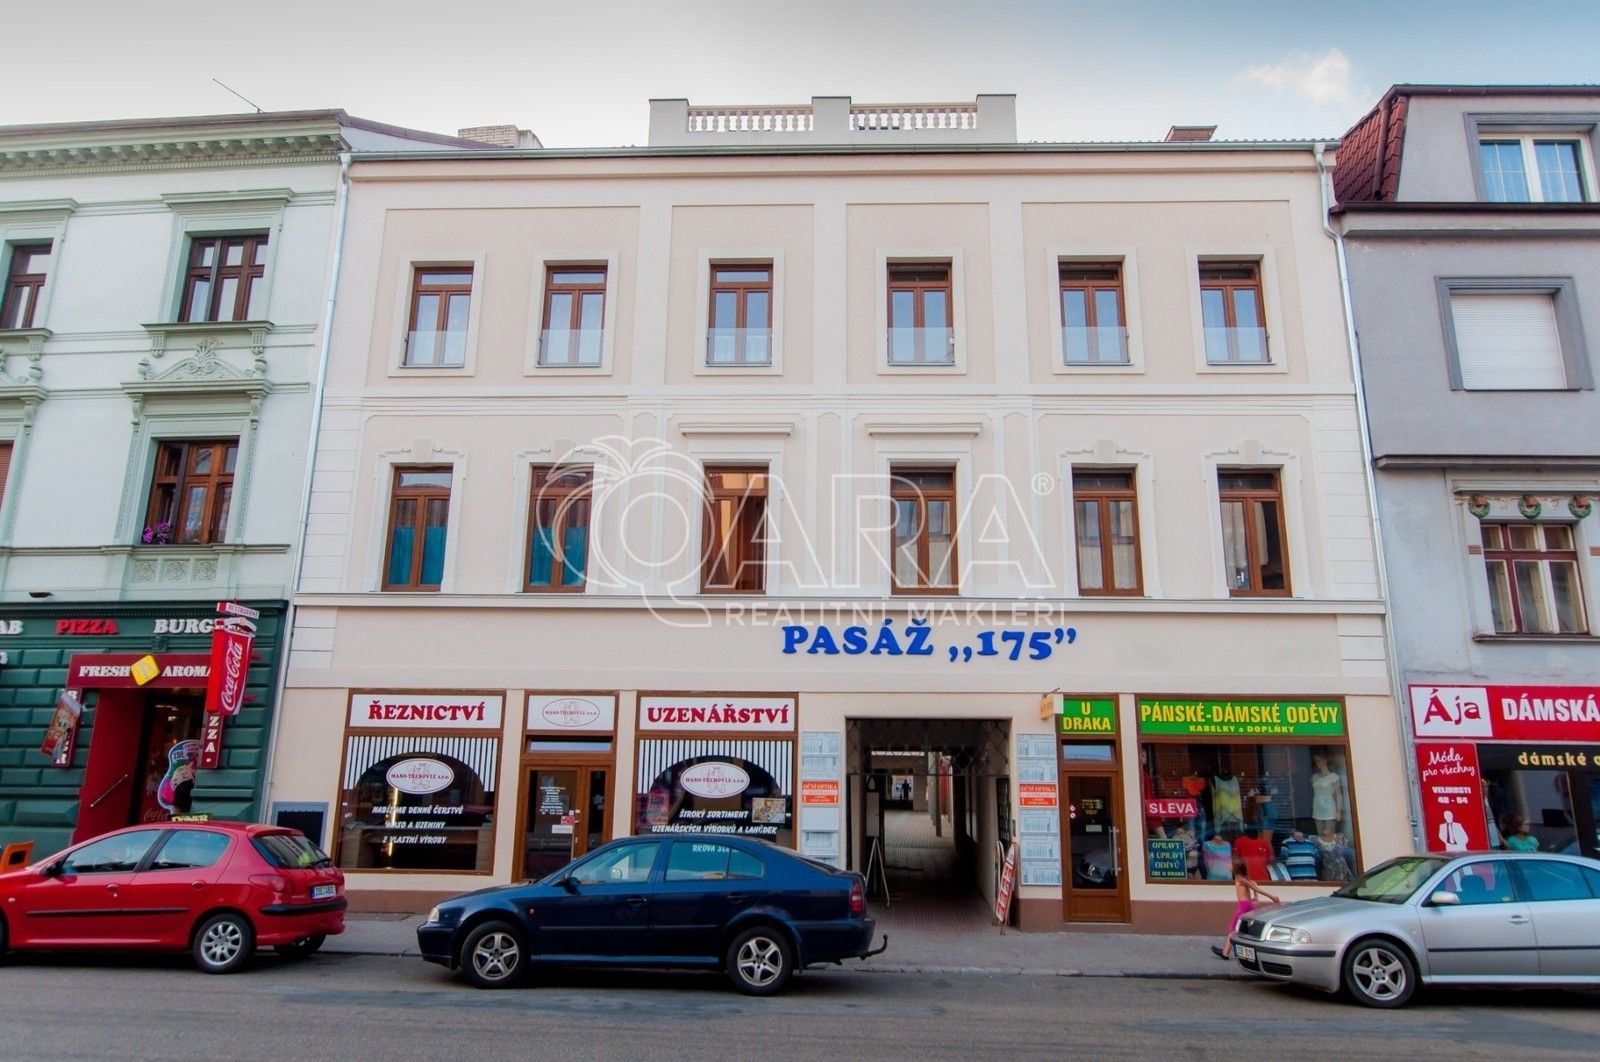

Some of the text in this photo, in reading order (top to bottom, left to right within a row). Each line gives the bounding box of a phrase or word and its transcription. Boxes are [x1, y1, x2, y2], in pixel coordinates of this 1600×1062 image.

[55, 619, 118, 634] PIZZA
[782, 619, 934, 656] PASÁŽ
[79, 666, 131, 677] FRESH
[368, 701, 486, 721] ŘEZNICTVÍ
[647, 704, 789, 723] UZENÁŘSTVÍ
[1081, 702, 1091, 715] U
[1141, 702, 1339, 724] PÁNSKÉ-DÁMSKÉ ODĚVY
[1423, 689, 1482, 726] Ája
[1501, 693, 1600, 722] DÁMSKÁ
[1063, 717, 1112, 730] DRAKA
[1189, 725, 1236, 733] KABELKY
[1247, 725, 1295, 733] DOPLŇKY
[1427, 747, 1464, 766] Móda
[1518, 752, 1587, 766] dámské
[1422, 761, 1475, 782] pro všechny
[433, 804, 464, 814] ČERSTVÉ
[679, 808, 749, 819] ŠIROKÝ SORTIMENT
[1149, 803, 1195, 814] SLEVA
[408, 821, 413, 829] A
[415, 821, 446, 829] UZENINY
[652, 823, 701, 833] UZENÁŘSKÝCH
[704, 823, 737, 834] VÝROBKŮ
[738, 826, 743, 834] A
[390, 835, 419, 844] VLASTNÍ
[420, 835, 447, 844] VÝROBY
[1156, 851, 1185, 859] ÚPRAVY
[1155, 860, 1180, 869] ODĚVŮ
